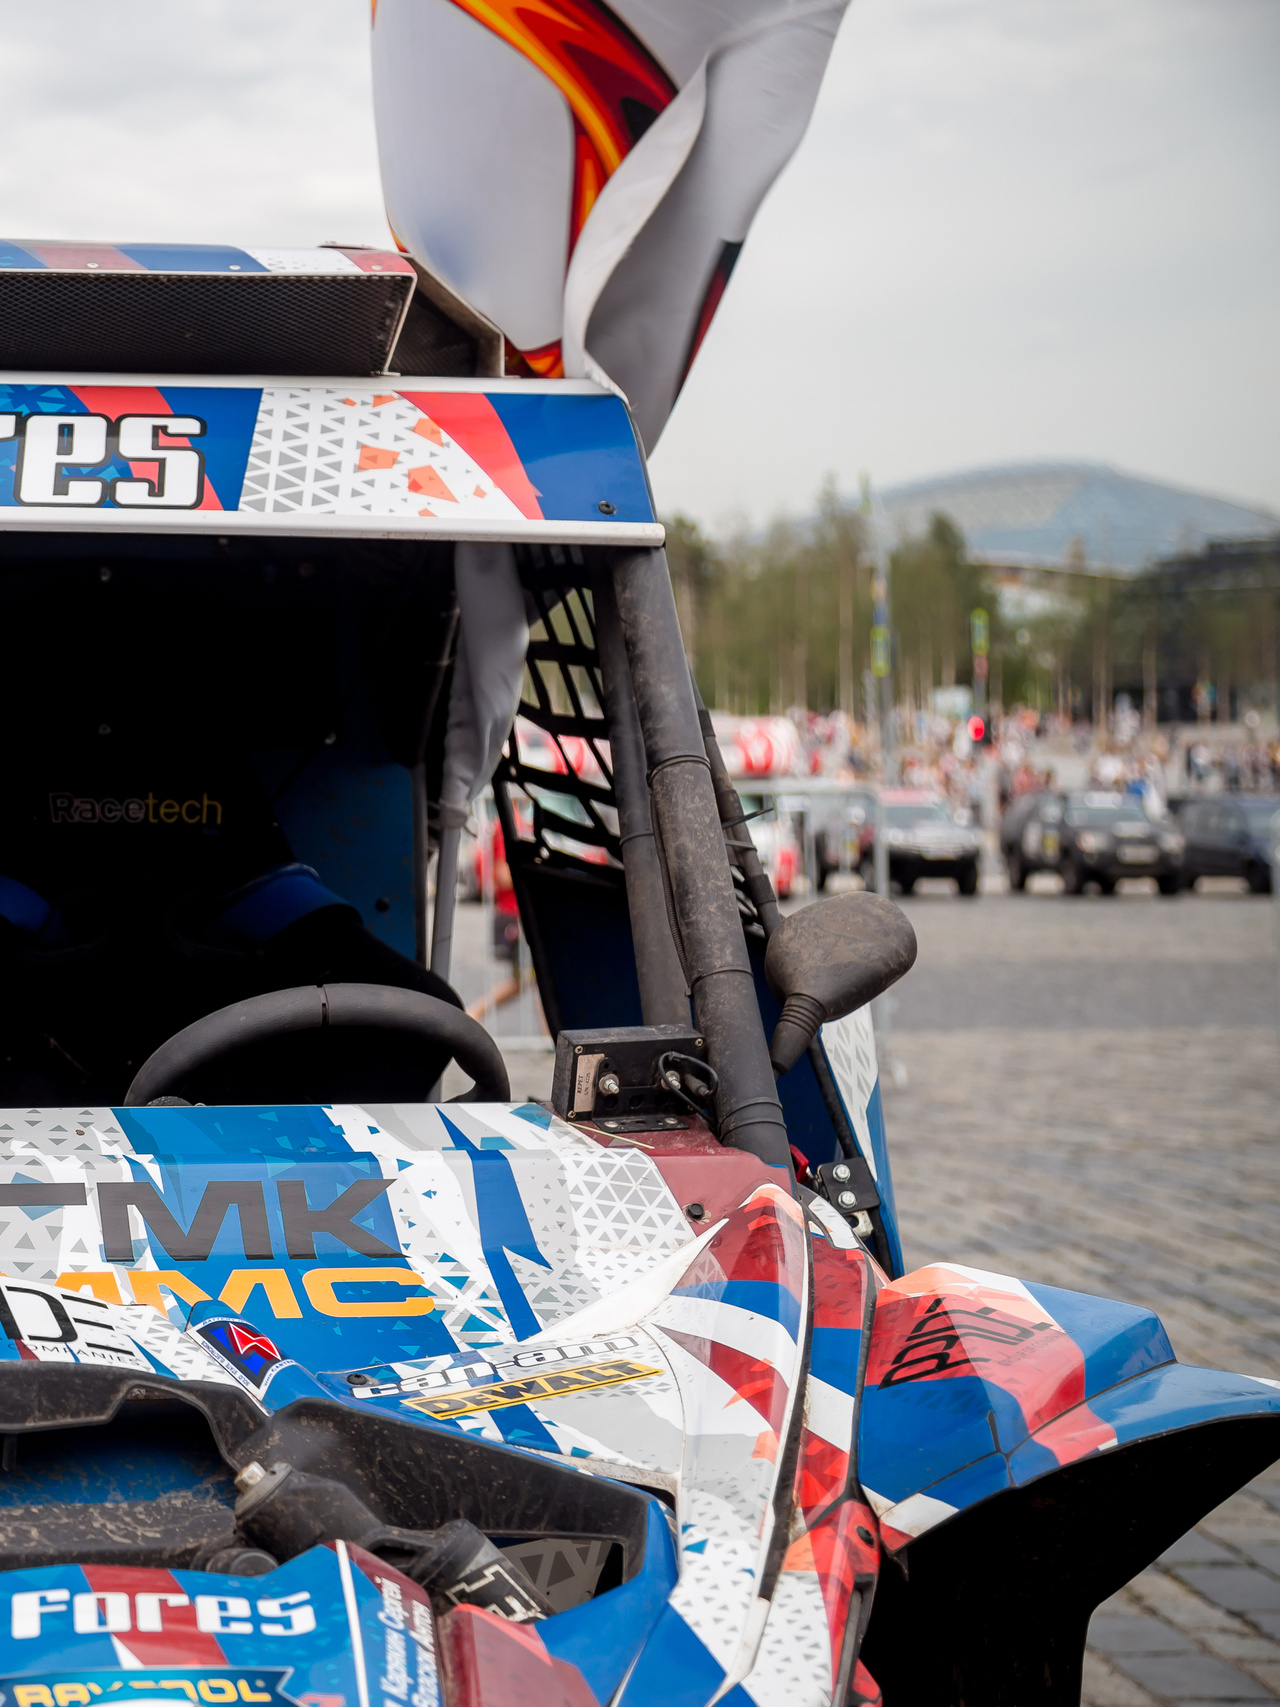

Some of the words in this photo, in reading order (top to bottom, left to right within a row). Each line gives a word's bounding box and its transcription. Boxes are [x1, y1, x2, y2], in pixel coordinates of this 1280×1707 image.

[47, 790, 224, 827] Racetech
[7, 1342, 143, 1368] COMPANIES
[416, 1361, 645, 1414] DEWALT
